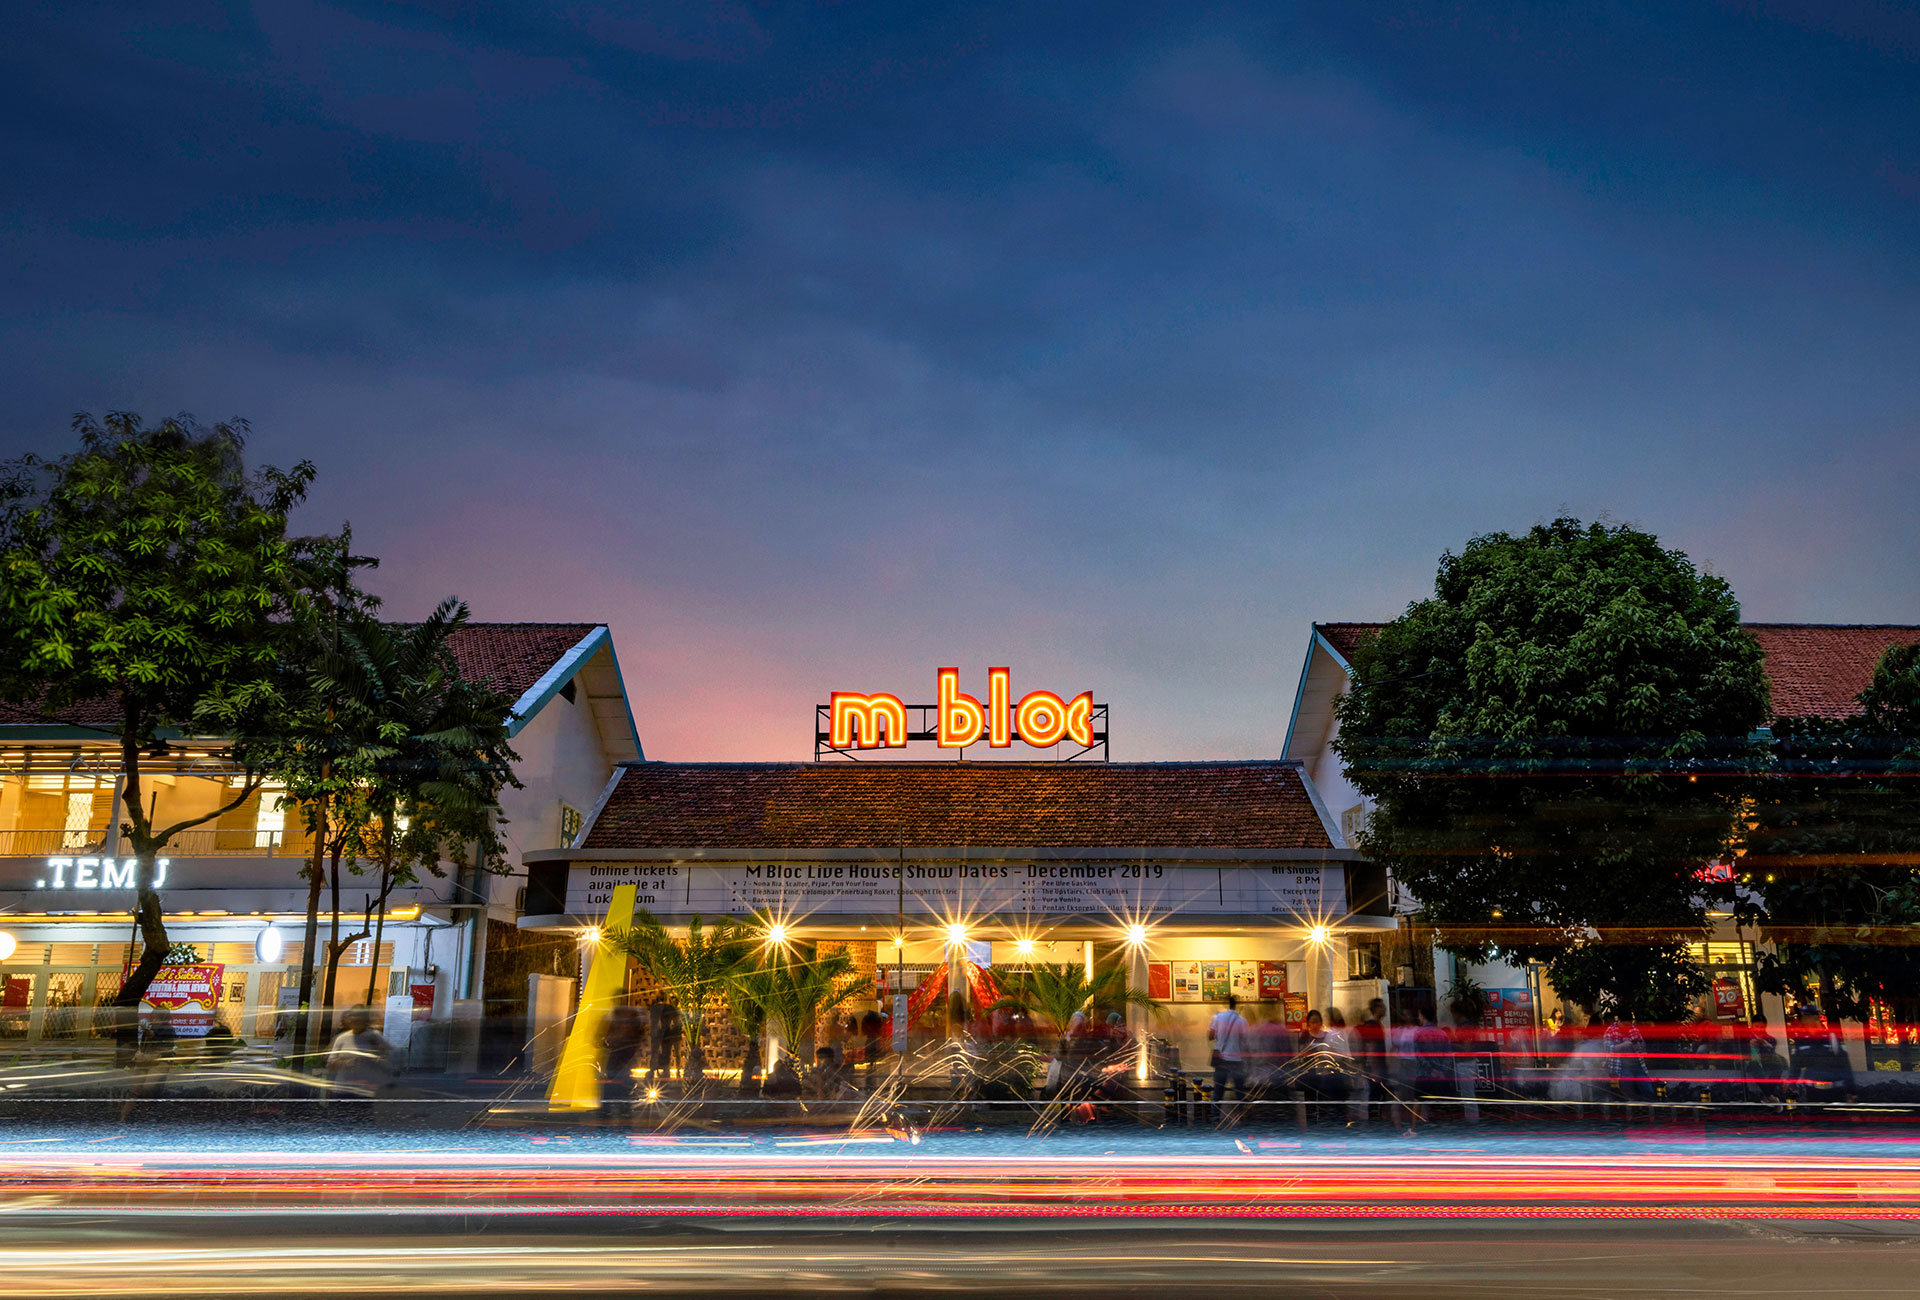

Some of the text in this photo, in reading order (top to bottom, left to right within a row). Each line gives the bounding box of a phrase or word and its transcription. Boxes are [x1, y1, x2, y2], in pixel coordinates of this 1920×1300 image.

[829, 666, 1094, 748] m bloc
[590, 865, 678, 876] Online tickets
[746, 864, 762, 878] M
[766, 864, 802, 879] Bloc
[808, 864, 843, 879] Live
[850, 864, 901, 879] House
[907, 864, 953, 879] Show
[959, 864, 1008, 879] Dates
[1028, 864, 1116, 878] December
[1121, 864, 1163, 878] 2019
[1272, 866, 1320, 875] All Shows
[652, 880, 665, 890] at
[1296, 876, 1320, 884] 8 PM
